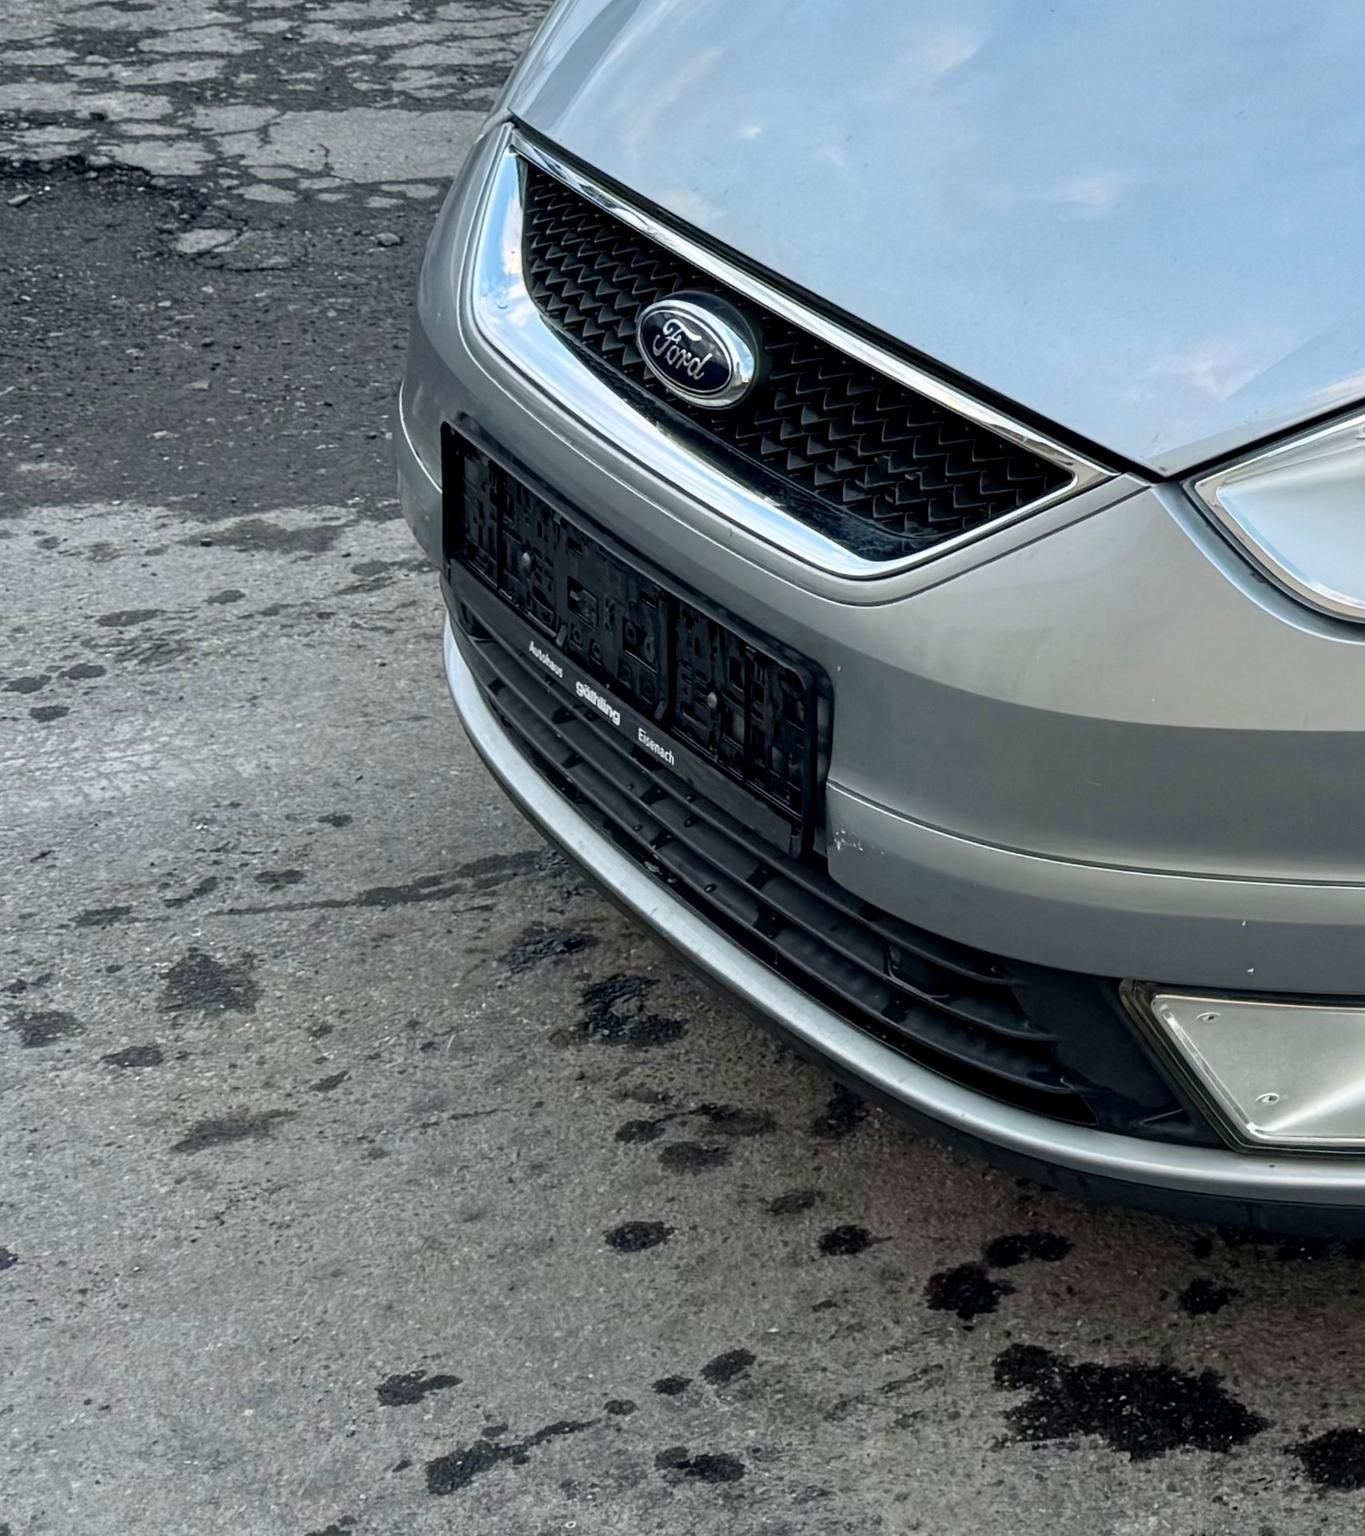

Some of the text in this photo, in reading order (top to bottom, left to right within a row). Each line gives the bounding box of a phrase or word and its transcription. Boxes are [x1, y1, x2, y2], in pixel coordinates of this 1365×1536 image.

[653, 318, 713, 381] Ford
[528, 640, 564, 679] Autohaus
[638, 727, 675, 766] Eisenach
